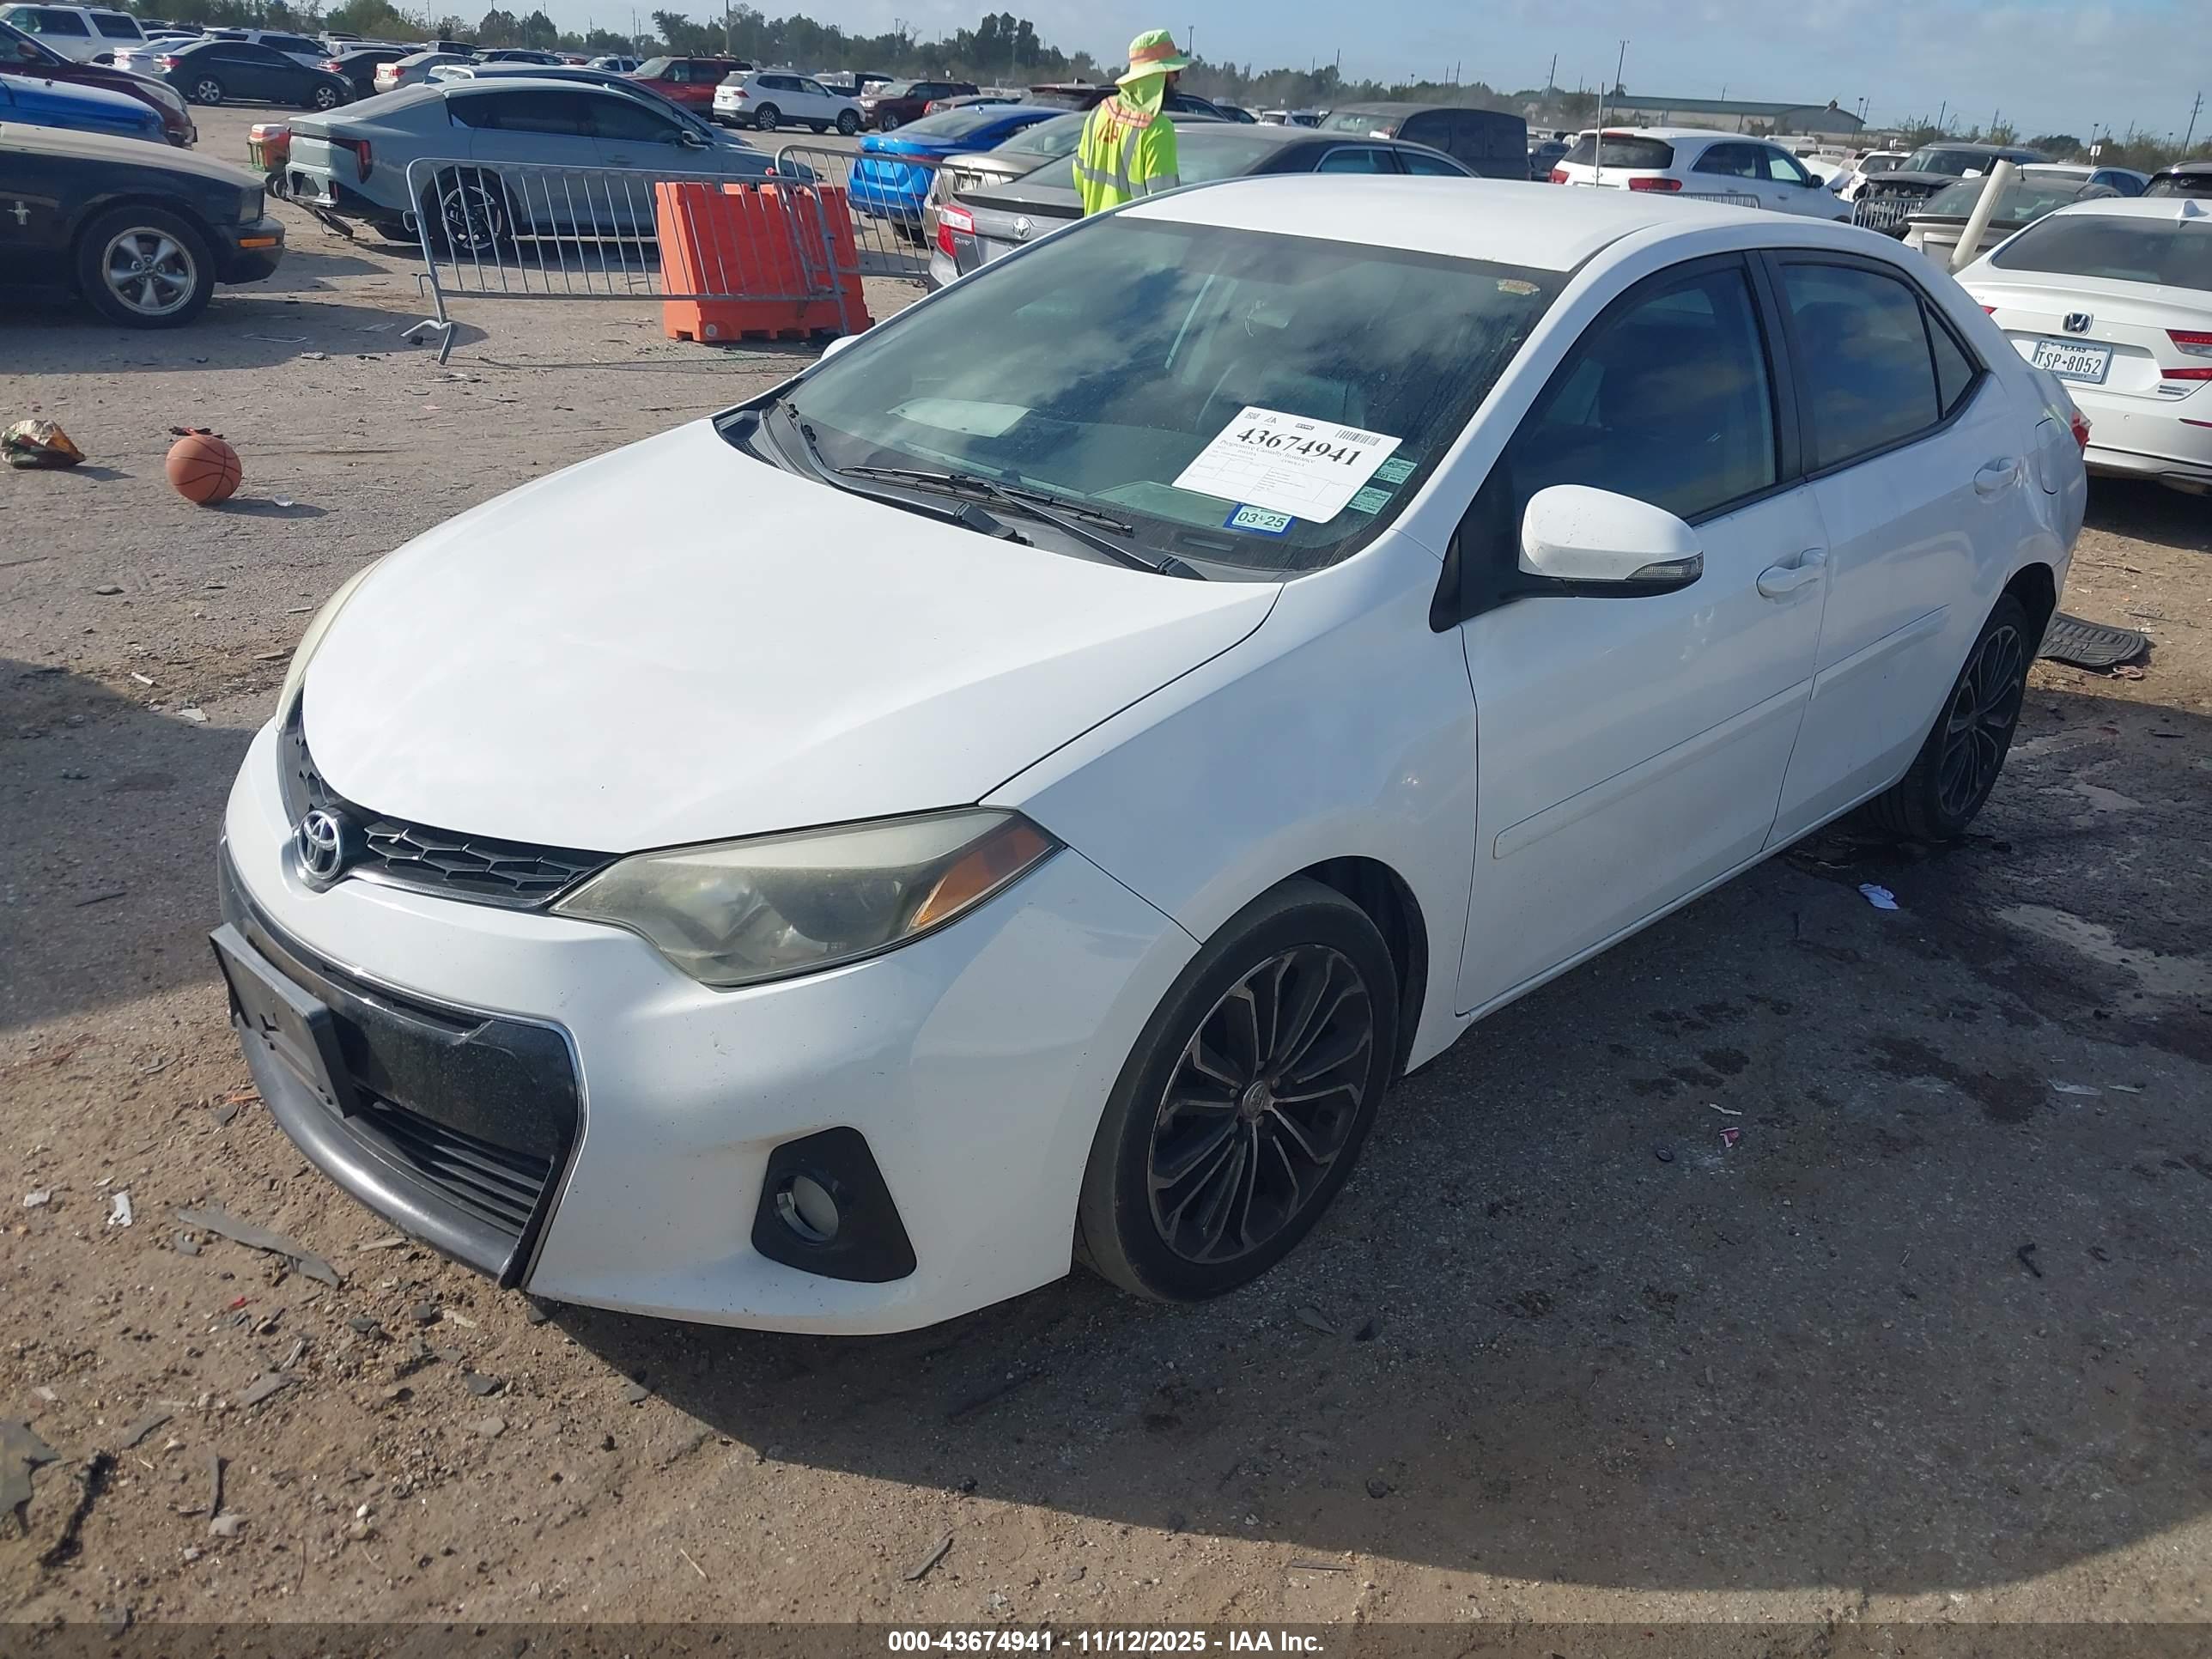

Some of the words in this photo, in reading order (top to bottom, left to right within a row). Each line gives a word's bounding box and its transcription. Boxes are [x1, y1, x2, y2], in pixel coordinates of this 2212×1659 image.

[1237, 428, 1362, 466] 43674941
[1237, 511, 1259, 523] 03
[1263, 515, 1286, 528] 25
